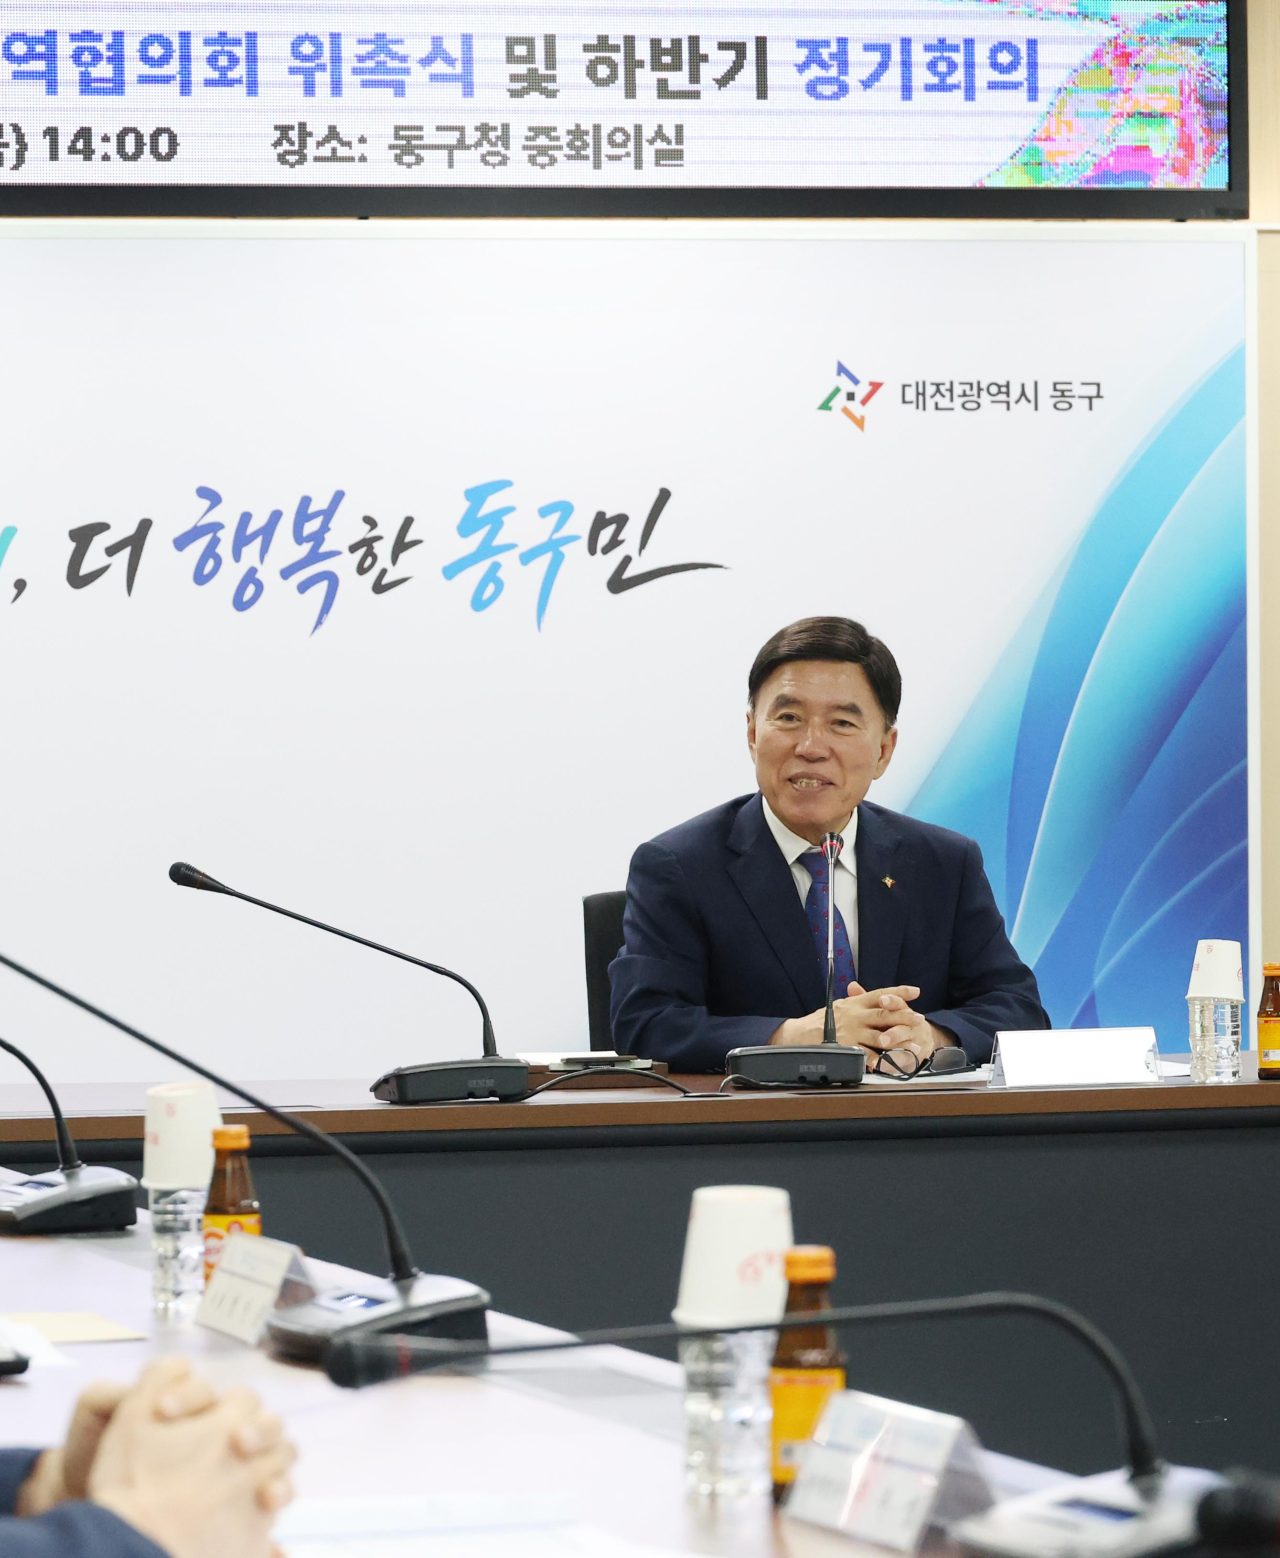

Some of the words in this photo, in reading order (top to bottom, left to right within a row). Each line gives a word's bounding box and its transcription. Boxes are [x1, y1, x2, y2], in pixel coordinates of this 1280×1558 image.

[287, 31, 475, 99] 위촉식
[503, 32, 559, 100] 및
[582, 34, 769, 102] 하반기
[795, 35, 1040, 102] 정기회의
[41, 125, 180, 163] 14:00
[271, 120, 368, 169] 장소:
[387, 121, 512, 170] 동구청
[900, 379, 1040, 412] 대전광역시
[1049, 380, 1105, 412] 동구
[64, 517, 154, 598] 더
[171, 485, 425, 638] 행복한
[440, 478, 734, 635] 동구민
